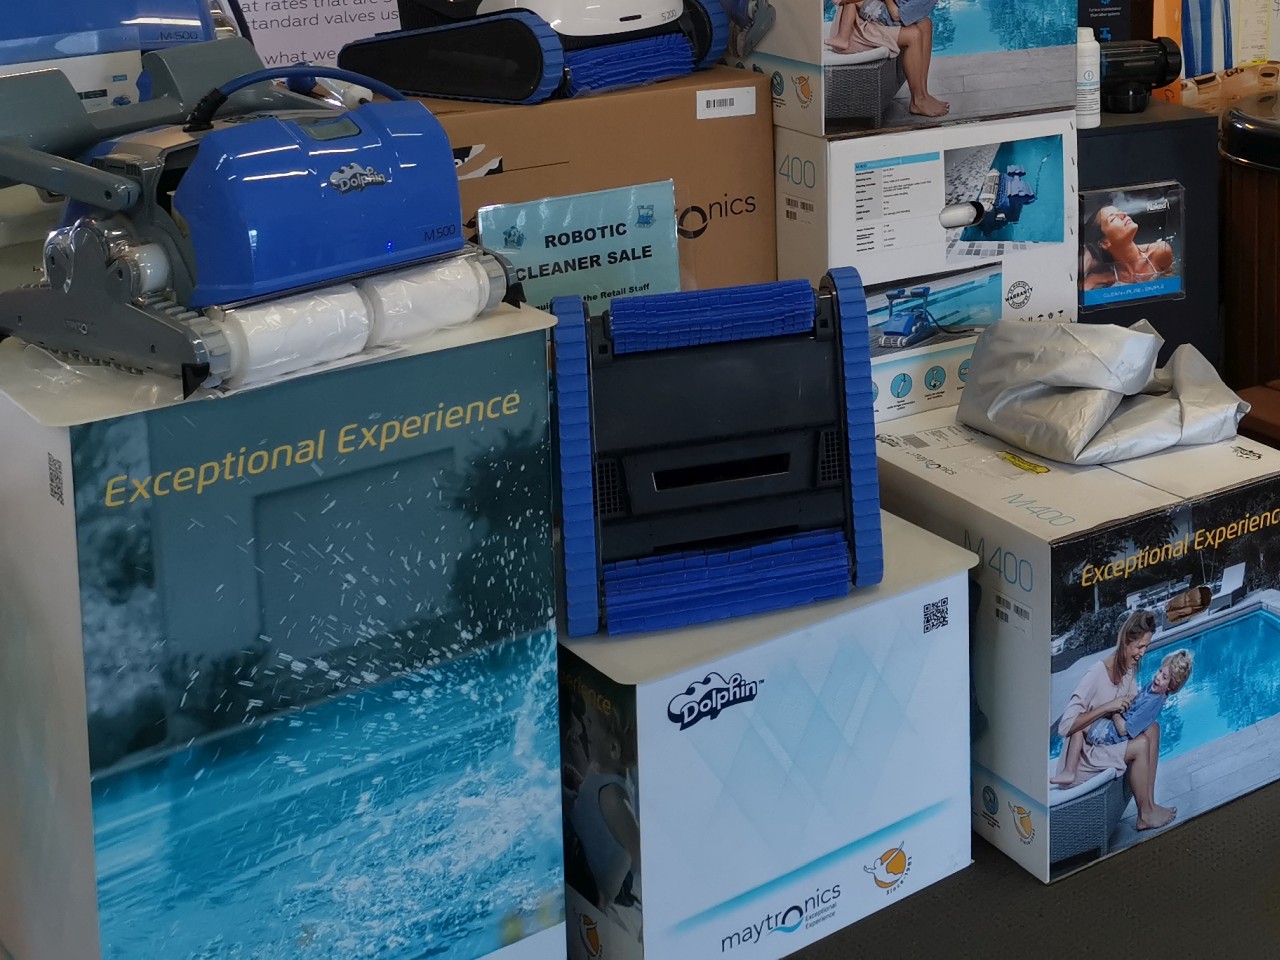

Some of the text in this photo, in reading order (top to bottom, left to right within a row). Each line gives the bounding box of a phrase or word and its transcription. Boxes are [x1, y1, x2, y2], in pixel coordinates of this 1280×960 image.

[240, 1, 261, 14] at
[325, 11, 375, 25] valves
[381, 9, 399, 21] us
[264, 50, 336, 65] what we
[338, 169, 386, 191] Dolphin
[779, 154, 816, 189] 400
[1147, 198, 1167, 211] Naked
[544, 222, 627, 249] ROBOTIC
[515, 244, 653, 282] CLEANER SALE
[583, 283, 650, 302] the Retail Staff
[1005, 286, 1033, 302] WARRANTY
[104, 392, 521, 508] Exceptional Experience
[1081, 533, 1189, 589] Exceptional
[681, 677, 758, 725] Dolphin
[721, 884, 841, 952] maytronics
[805, 902, 837, 922] Exceptional
[805, 911, 836, 930] Experience
